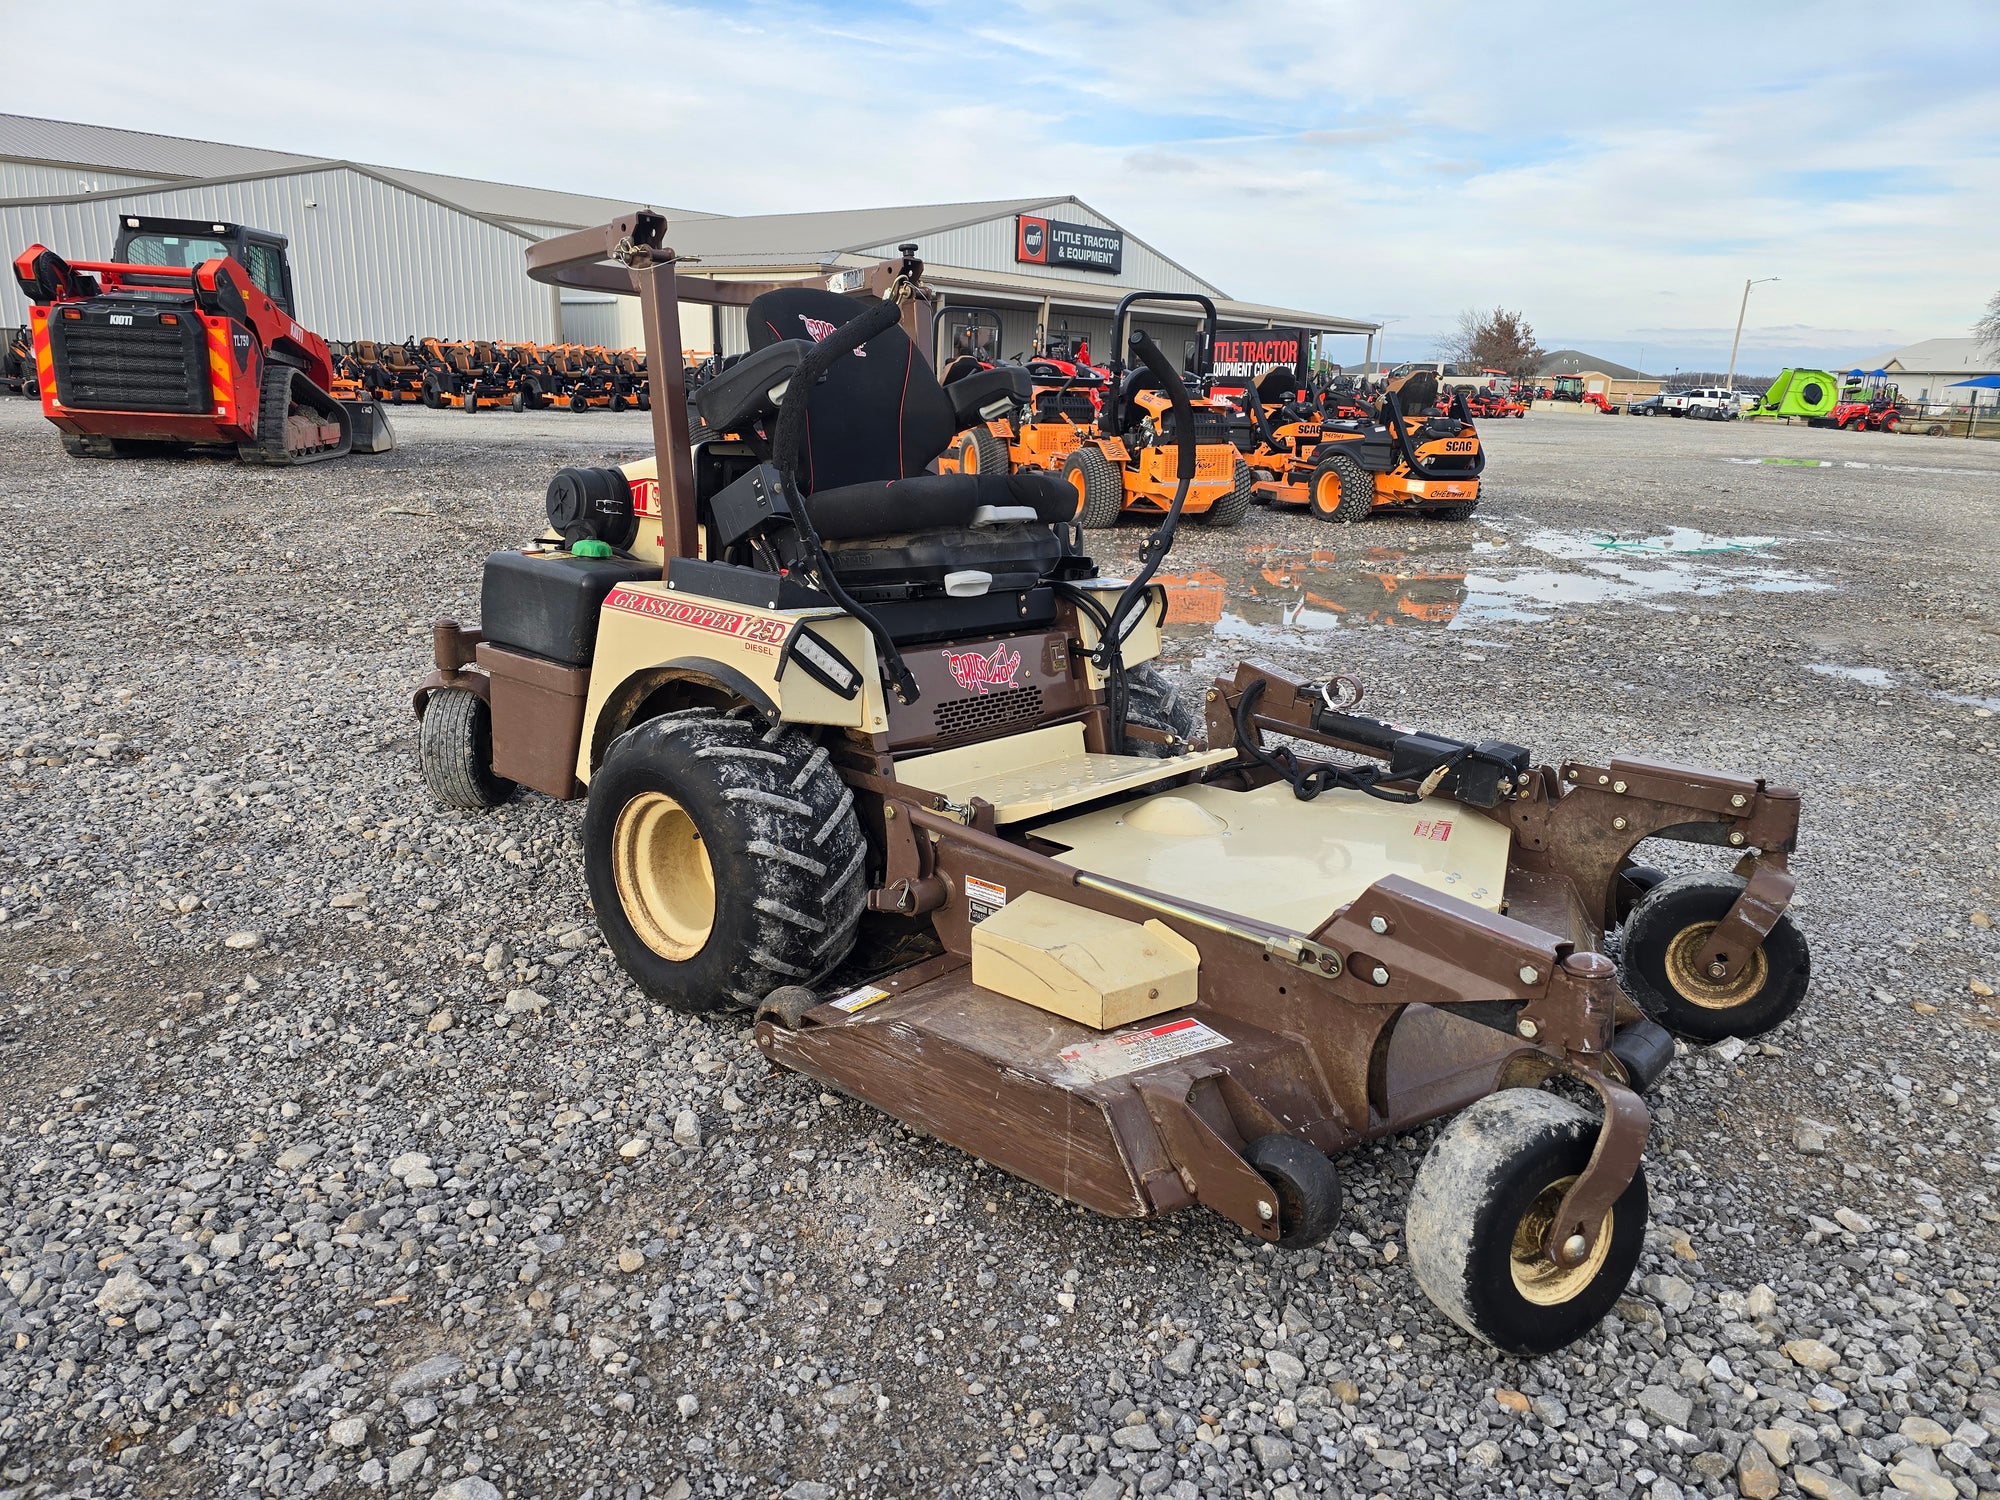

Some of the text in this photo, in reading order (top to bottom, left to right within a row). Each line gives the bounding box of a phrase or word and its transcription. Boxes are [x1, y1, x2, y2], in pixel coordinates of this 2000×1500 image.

[1053, 230, 1120, 251] LITTLE TRACTOR
[1058, 246, 1114, 264] & EQUIPMENT
[109, 314, 133, 326] KIOTI
[233, 334, 250, 347] TL750
[1241, 340, 1298, 363] TRACTOR
[1213, 362, 1253, 378] QUIPMENT
[1446, 441, 1473, 452] SCAG
[613, 592, 786, 643] GRASSHOPPER 725D
[744, 642, 774, 656] DIESEL
